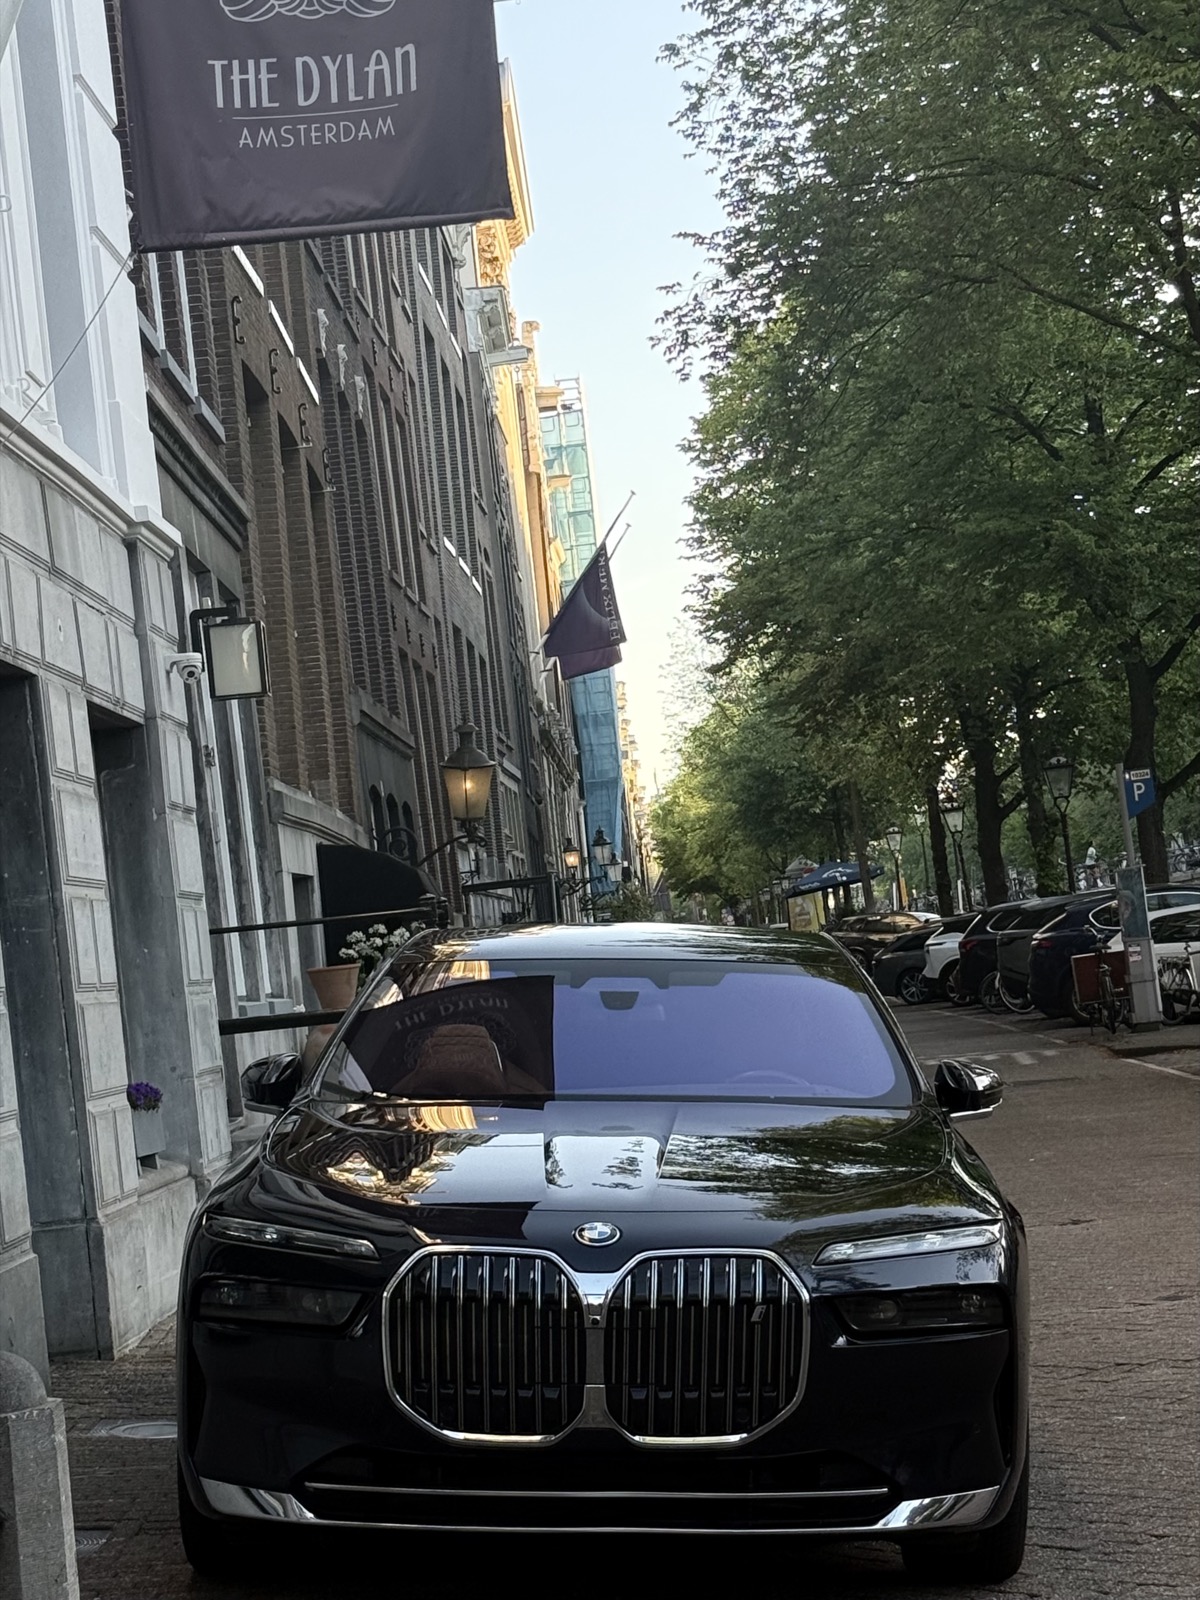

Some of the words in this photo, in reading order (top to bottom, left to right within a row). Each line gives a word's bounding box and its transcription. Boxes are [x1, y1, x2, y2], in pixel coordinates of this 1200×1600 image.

[207, 58, 280, 109] THE
[295, 43, 417, 108] DYLAN
[238, 116, 396, 149] AMSTERDAM
[603, 594, 621, 641] FELIX
[1133, 782, 1146, 802] P
